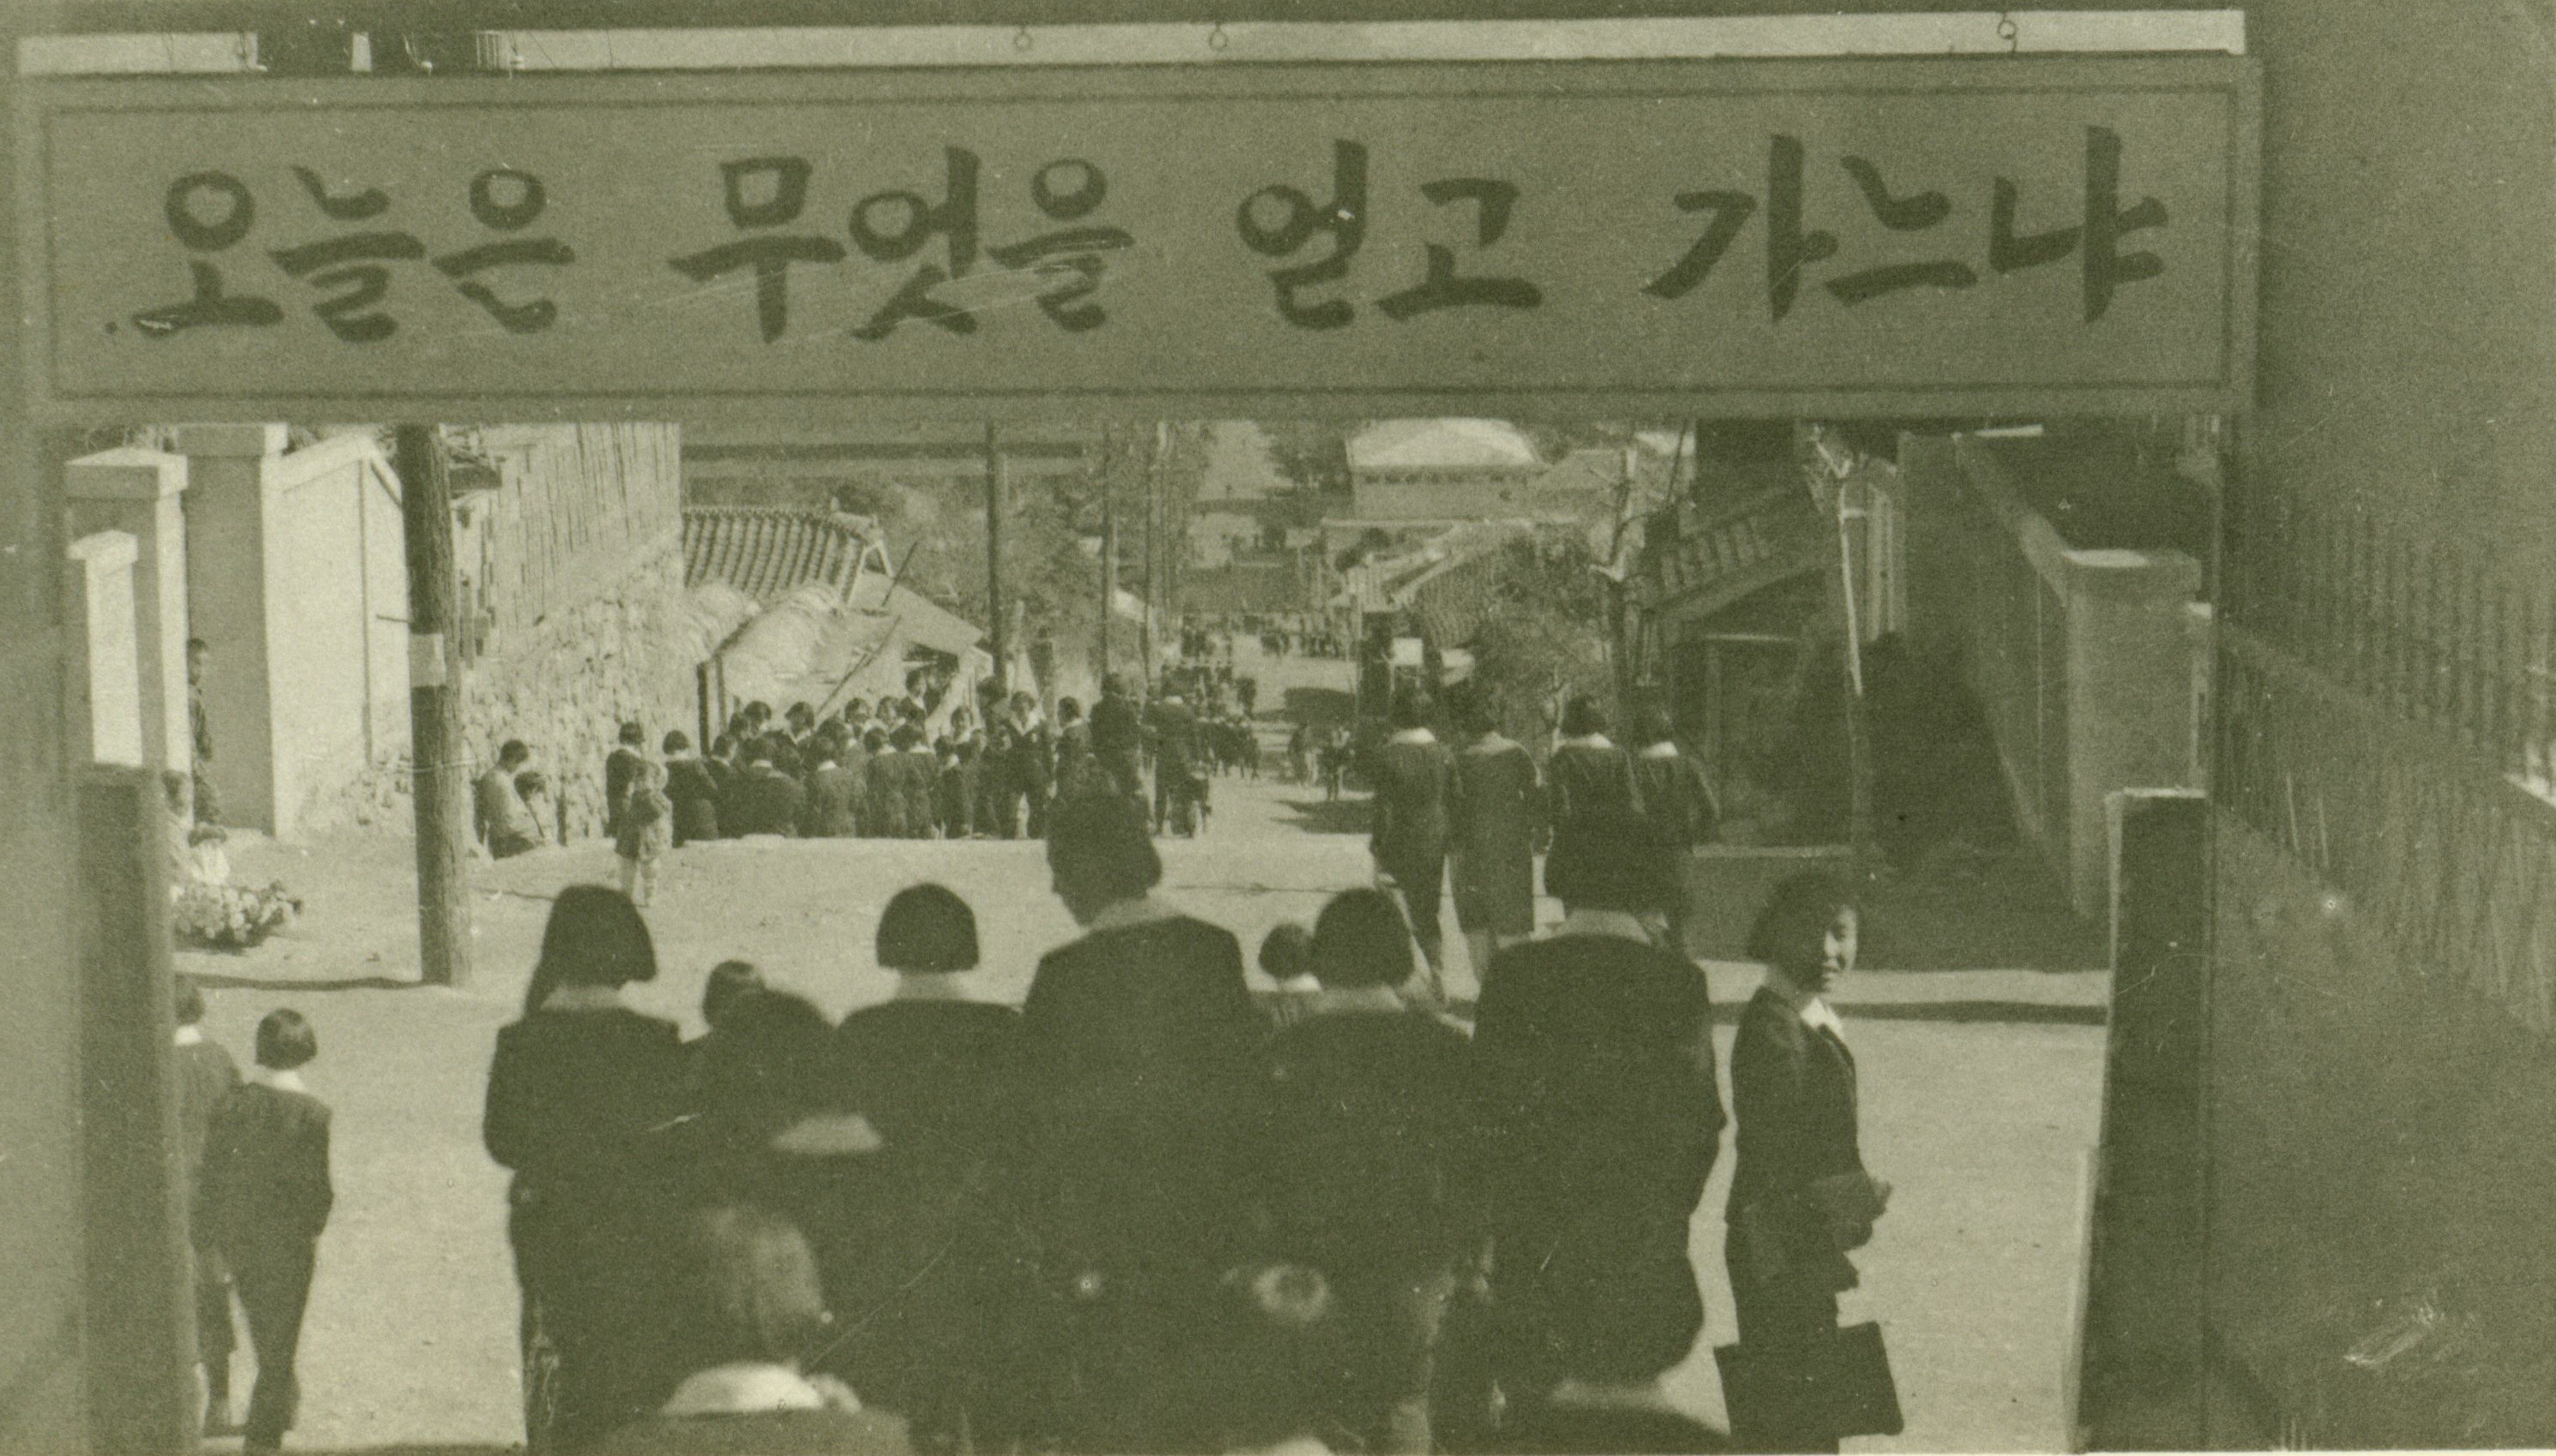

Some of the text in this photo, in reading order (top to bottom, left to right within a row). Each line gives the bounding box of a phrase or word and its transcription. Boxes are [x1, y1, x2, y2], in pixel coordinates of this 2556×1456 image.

[131, 127, 2167, 343] 오늘은 무엇을 얻고 가느냐
